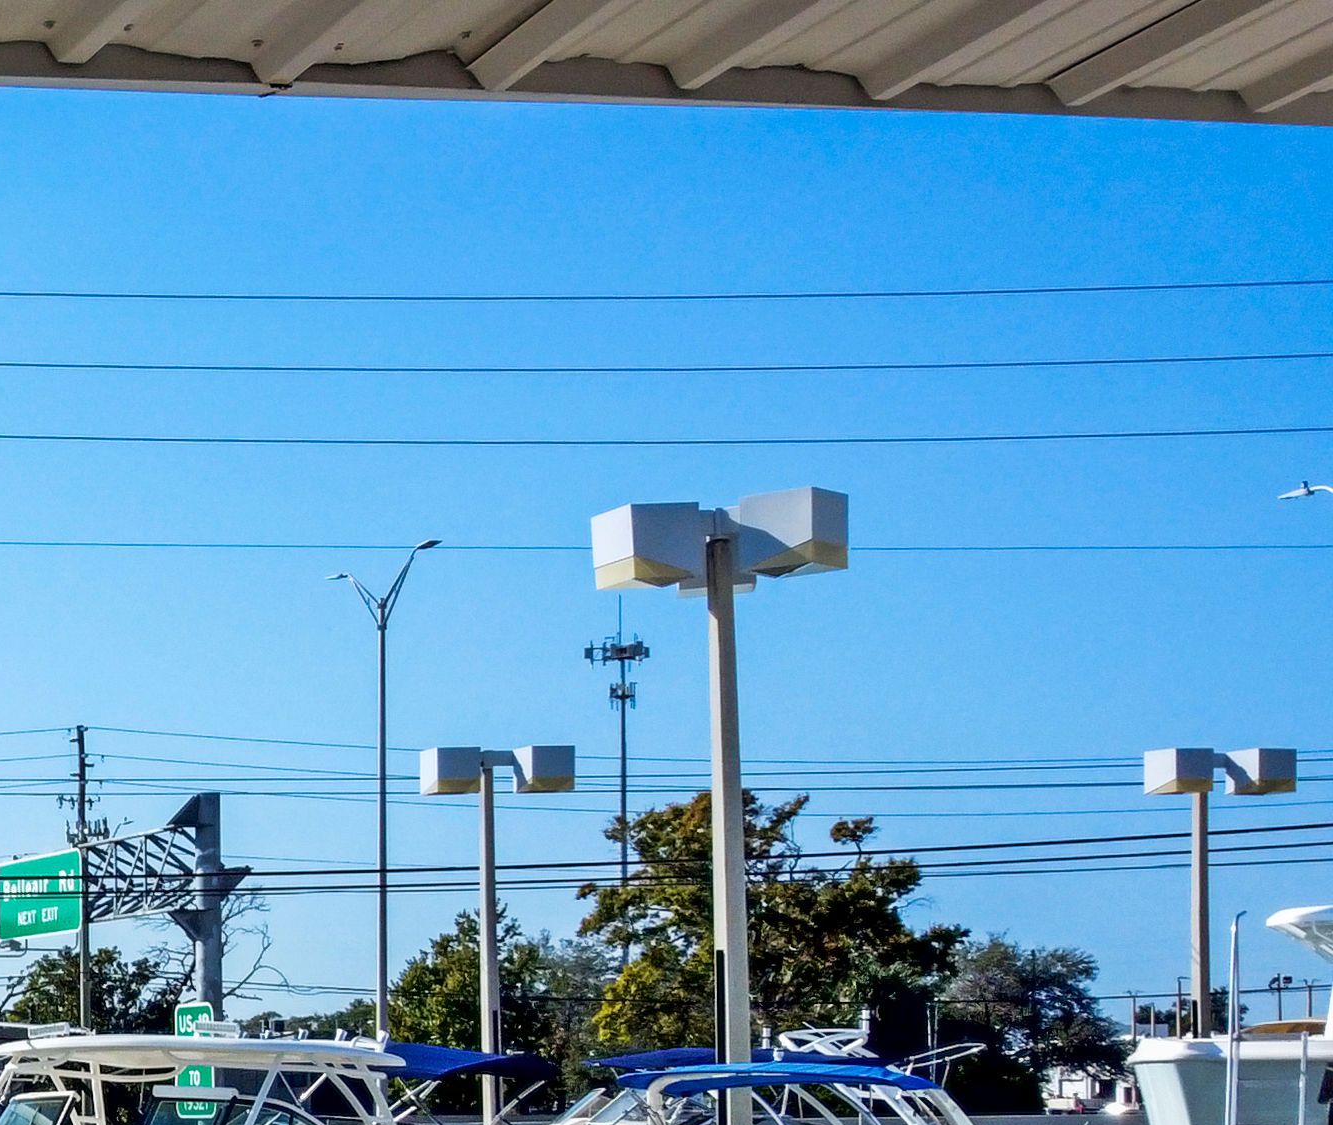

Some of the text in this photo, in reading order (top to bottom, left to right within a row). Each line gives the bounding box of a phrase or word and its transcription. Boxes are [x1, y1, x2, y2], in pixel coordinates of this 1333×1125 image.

[3, 869, 74, 902] Belleair Rd
[17, 906, 58, 926] NEXT EXIT
[189, 1070, 201, 1086] TO
